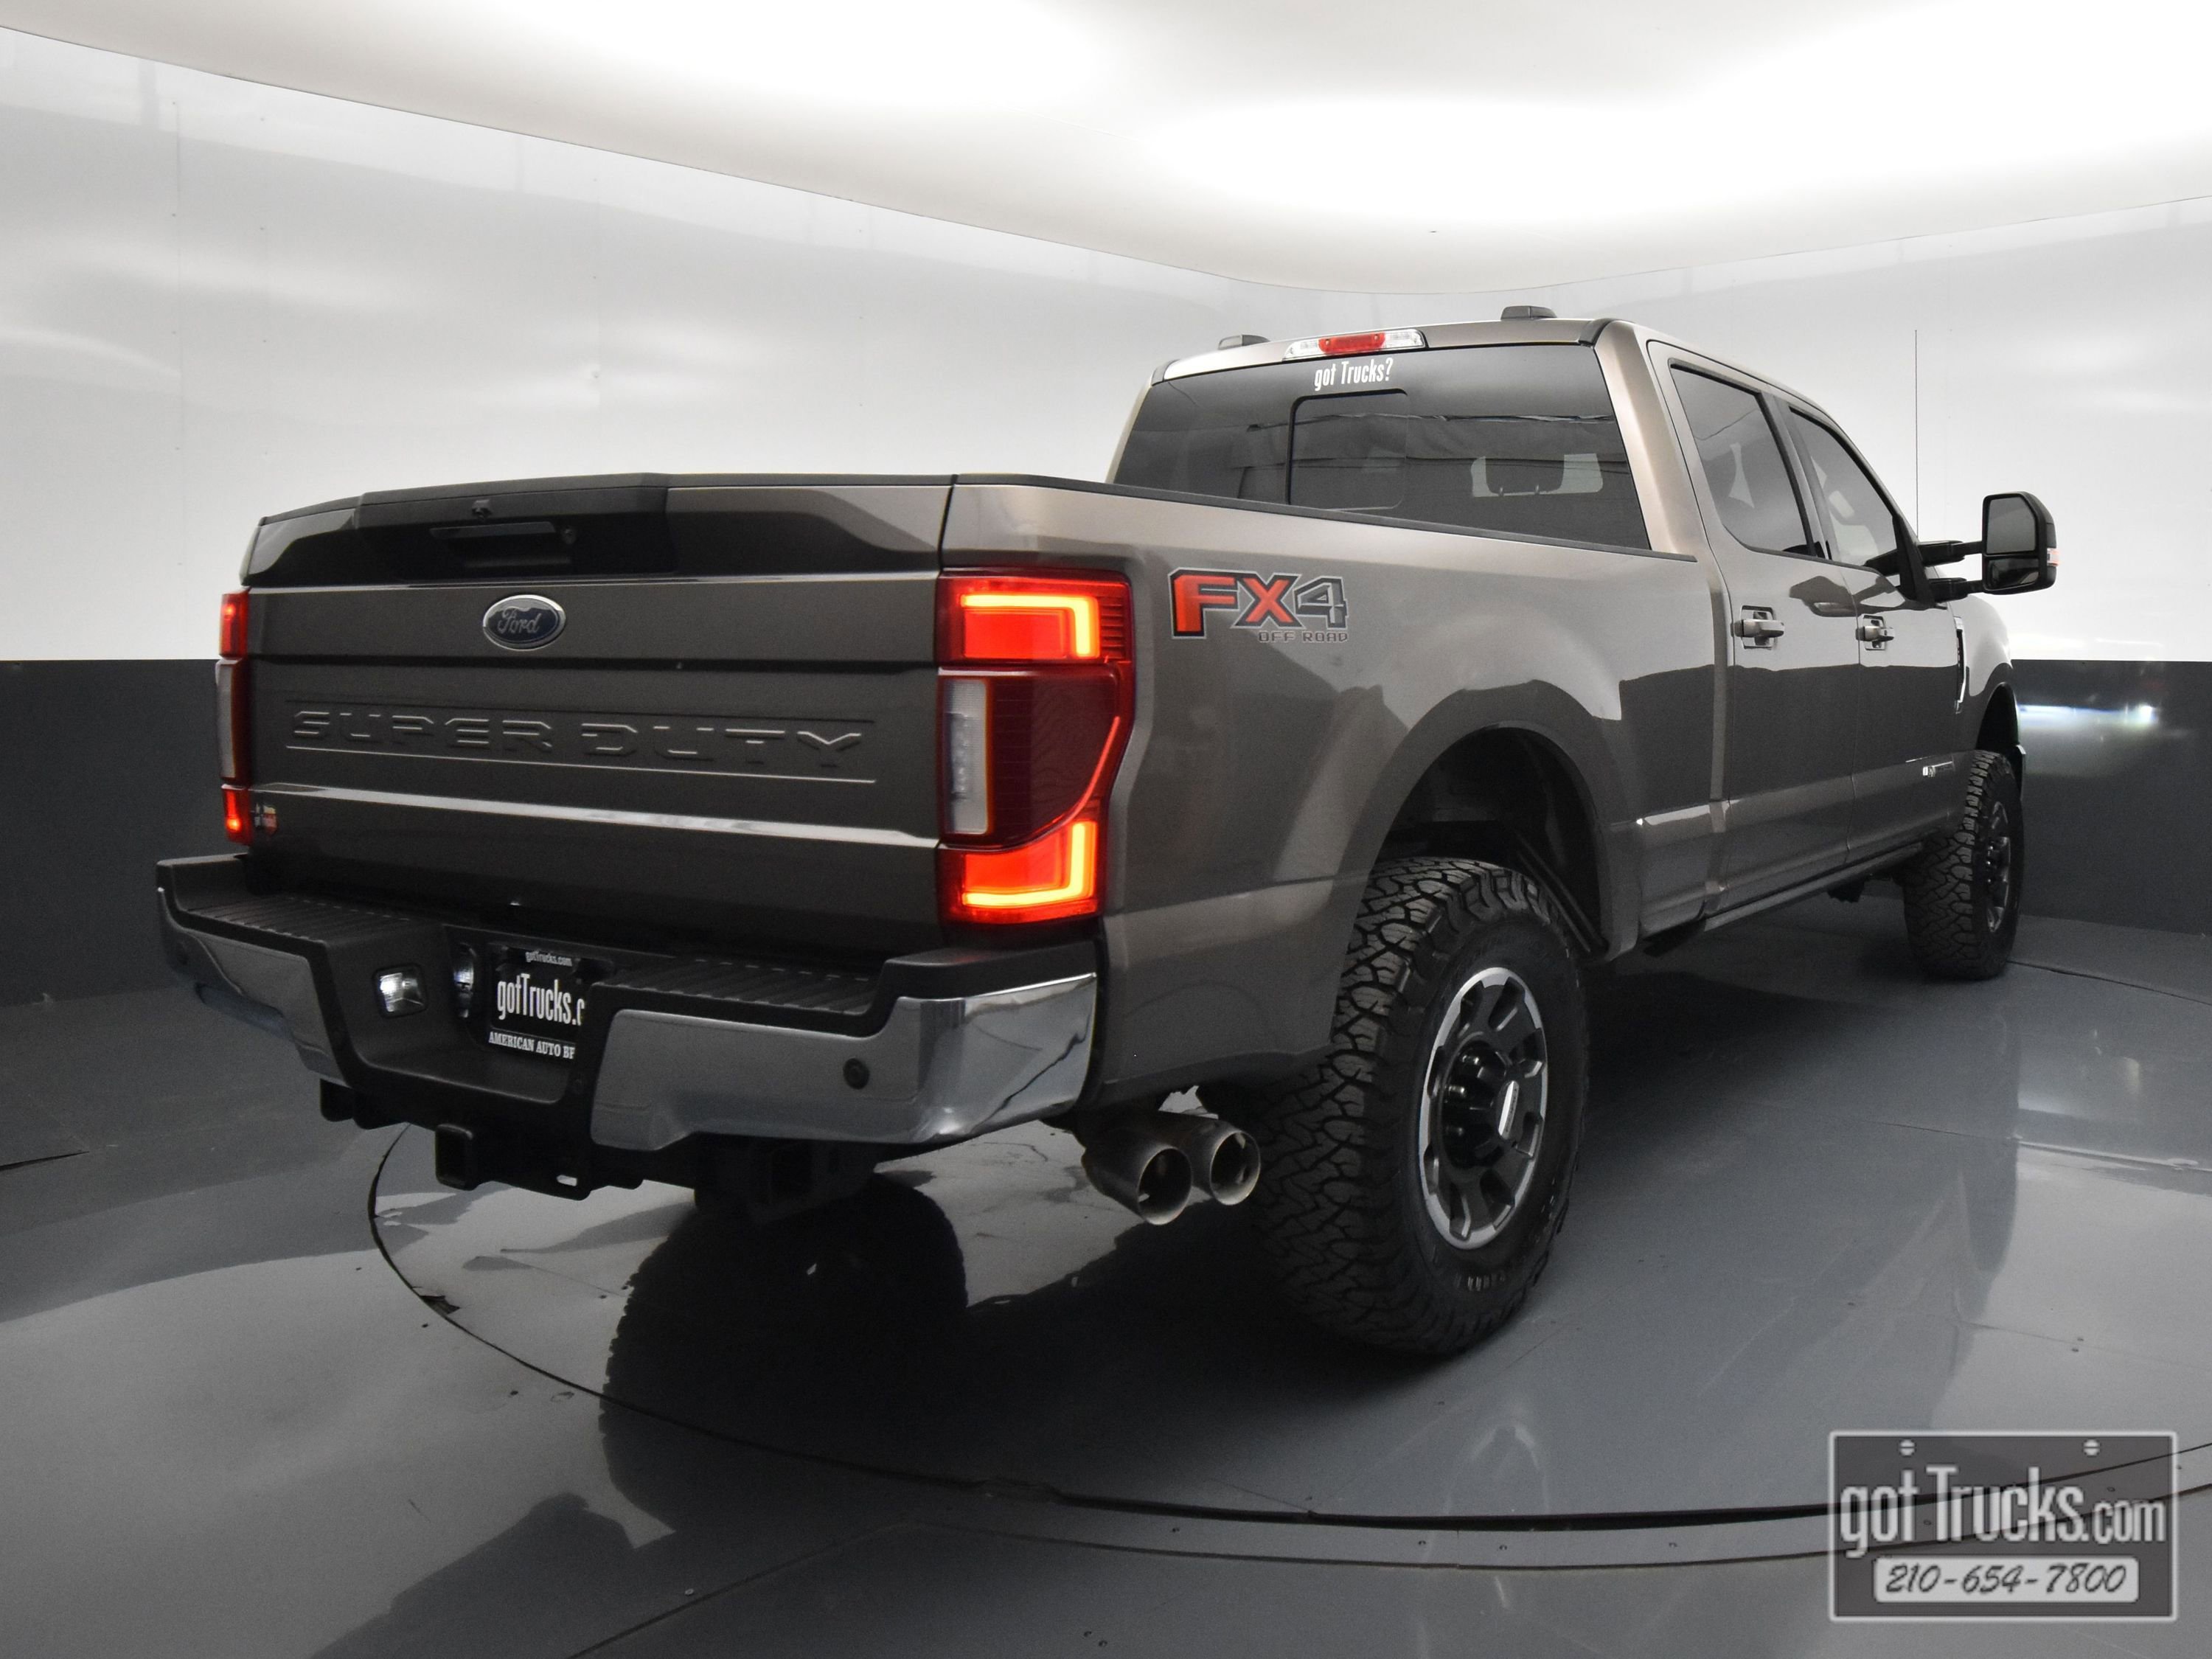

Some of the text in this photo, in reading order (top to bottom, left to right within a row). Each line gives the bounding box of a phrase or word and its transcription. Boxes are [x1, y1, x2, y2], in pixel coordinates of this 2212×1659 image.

[1315, 358, 1394, 392] got Trucks?
[1167, 567, 1349, 639] FX4
[496, 605, 543, 635] Ford
[1259, 630, 1349, 644] OFF ROAD
[293, 710, 863, 767] SUPER DUTY
[488, 1031, 535, 1052] AMERICAN
[535, 1040, 561, 1057] AUTO
